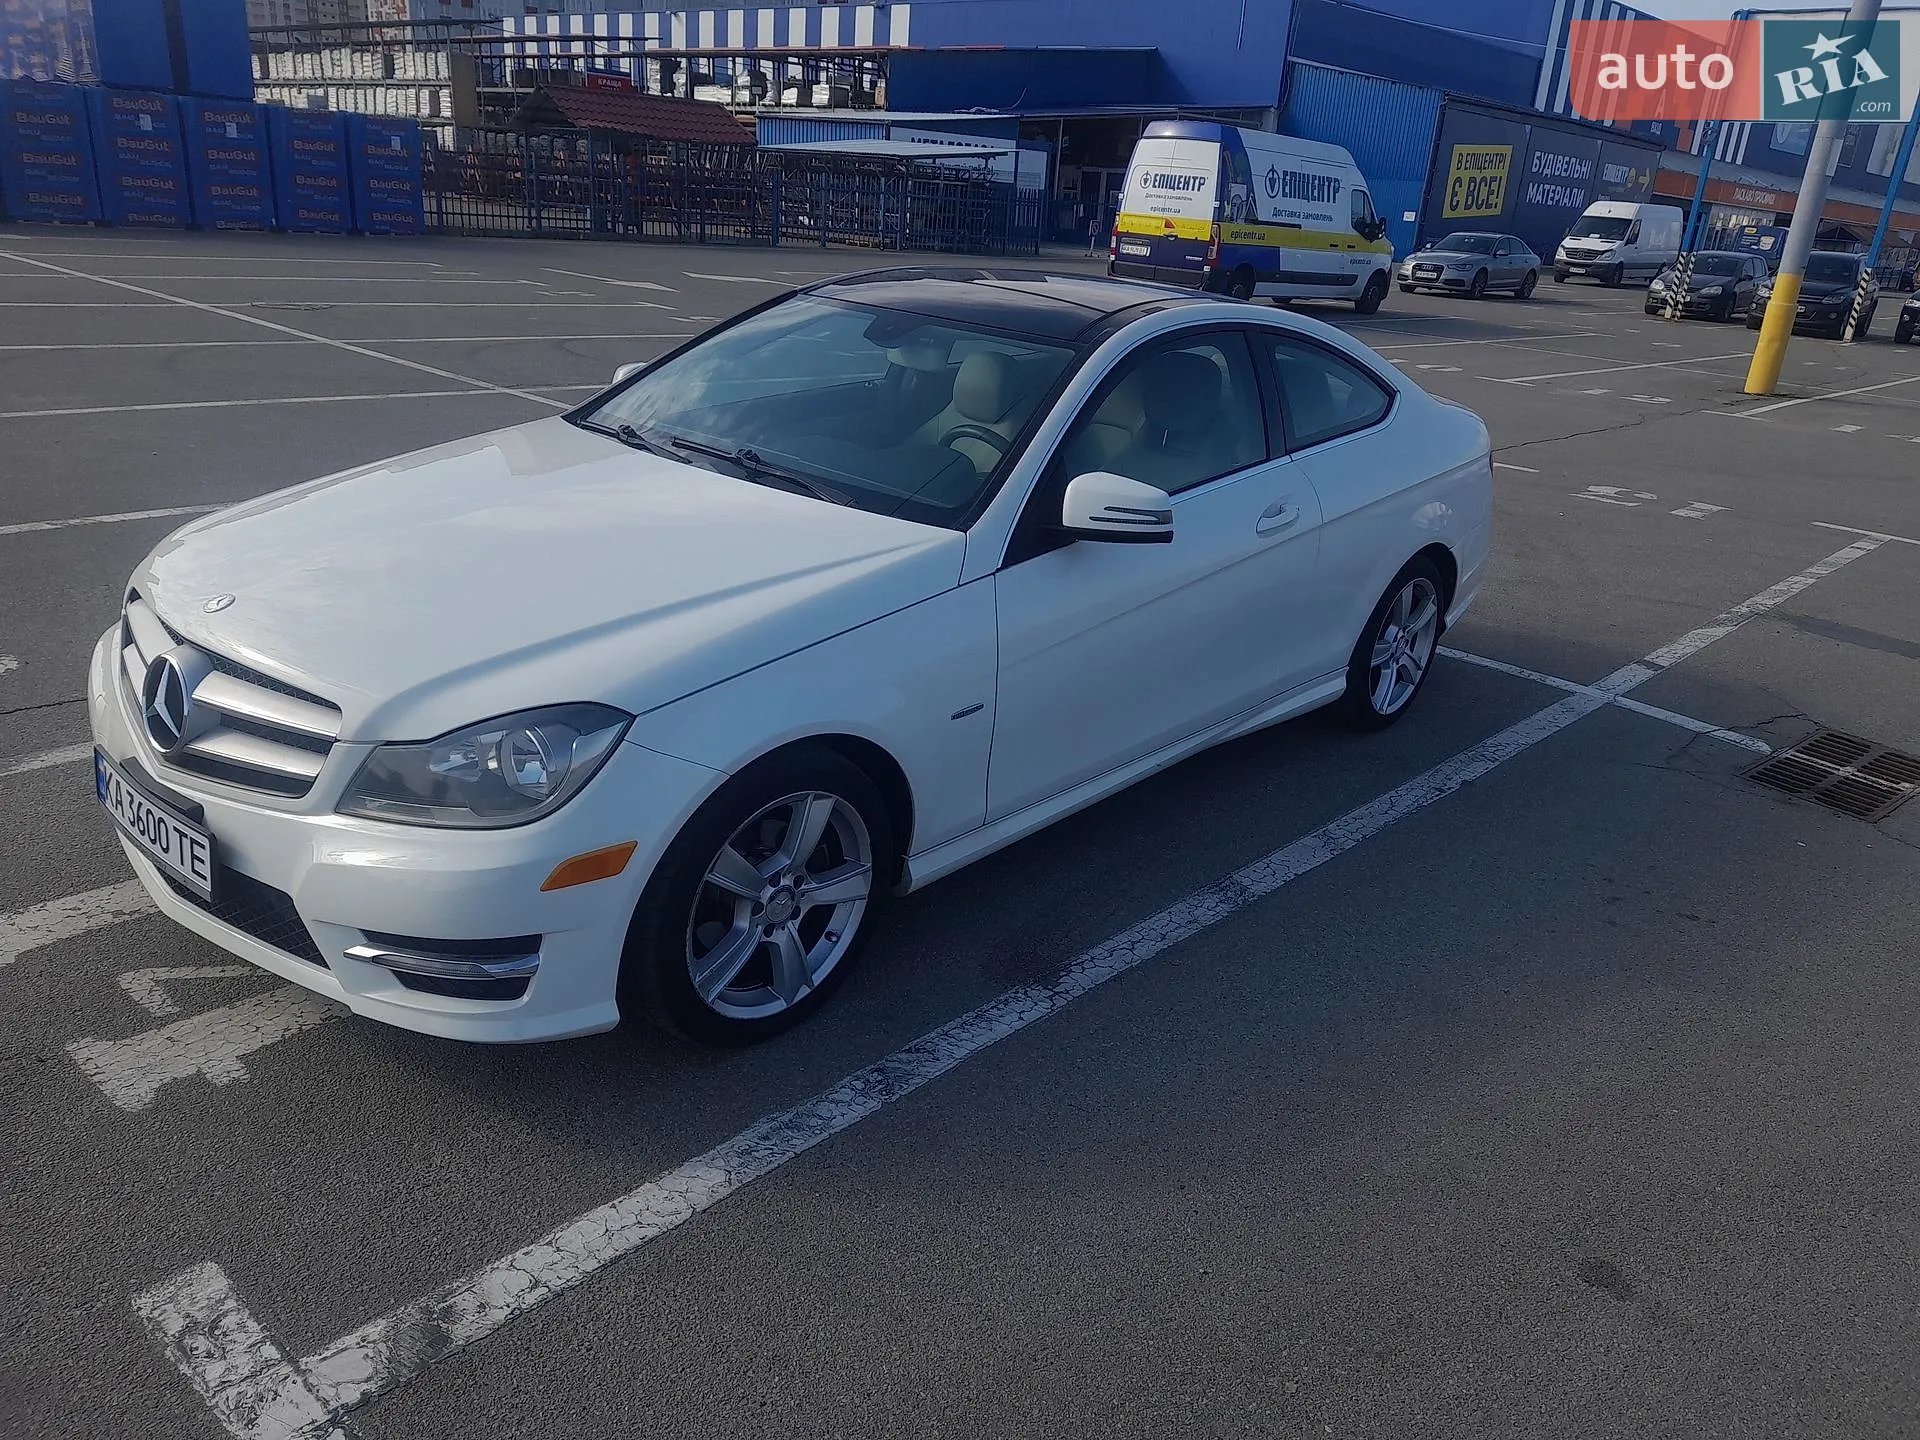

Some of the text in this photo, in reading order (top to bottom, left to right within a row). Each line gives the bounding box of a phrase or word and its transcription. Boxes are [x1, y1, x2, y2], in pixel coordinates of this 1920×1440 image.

[112, 97, 163, 112] BauGut
[16, 112, 72, 125] BauGut
[204, 111, 252, 124] BauGut
[117, 137, 170, 152] BauGut
[294, 139, 336, 152] BauGut
[22, 152, 78, 167] BauGut
[207, 149, 257, 161] BauGut
[1456, 152, 1508, 174] В ЕПІЦЕНТРІ
[1531, 151, 1592, 180] БУДІВЕЛЬНІ
[121, 176, 177, 190] BauGut
[296, 175, 337, 188] BauGut
[370, 178, 411, 191] BauGut
[1152, 173, 1207, 192] ЕПІЦЕНТР
[1282, 169, 1341, 204] ЕПІЦЕНТР
[210, 185, 258, 197] BauGut
[1449, 175, 1503, 212] Є ВСЕ!
[1526, 182, 1584, 208] МАТЕРІАЛИ
[127, 212, 177, 225] BauGut
[299, 209, 340, 222] BauGut
[373, 212, 415, 223] BauGut
[1272, 207, 1333, 222] Доставка замовлень
[1230, 229, 1266, 242] epicentr.ua
[104, 765, 208, 881] KA 3600 TE
